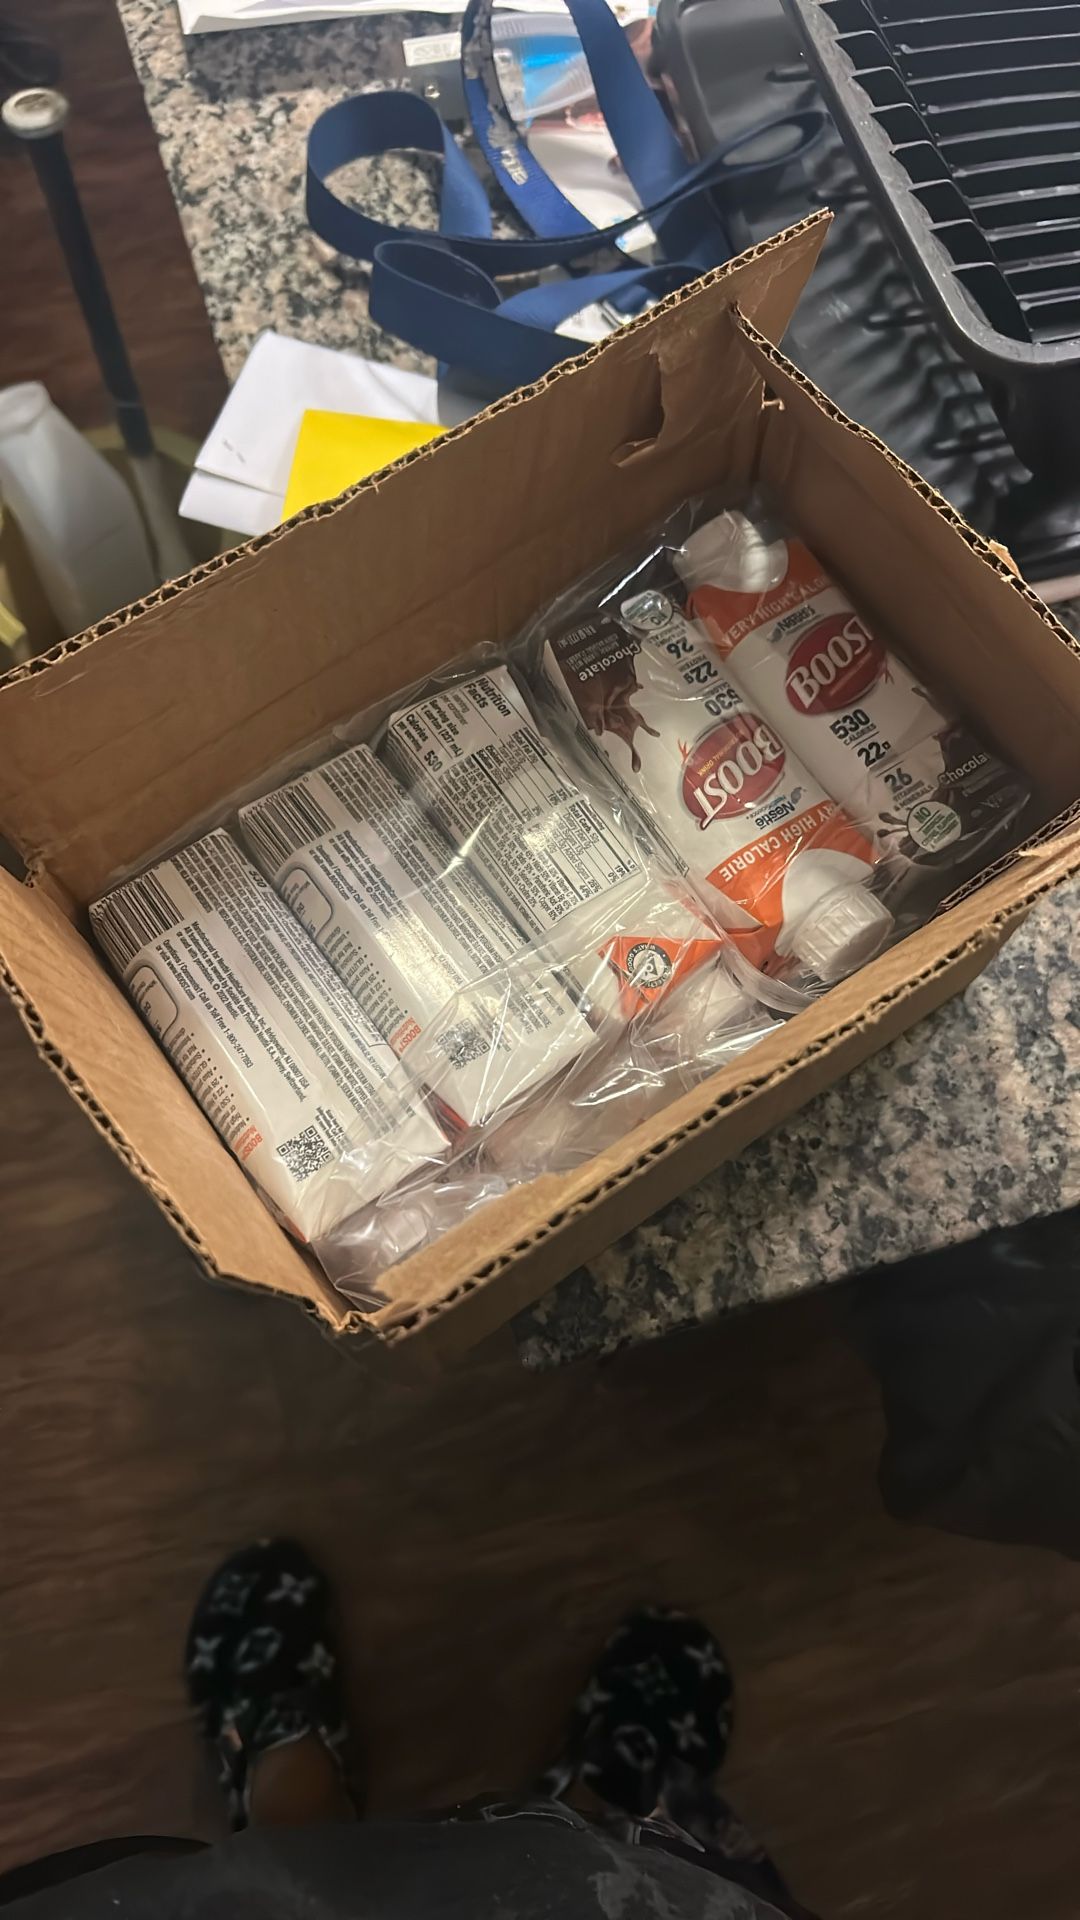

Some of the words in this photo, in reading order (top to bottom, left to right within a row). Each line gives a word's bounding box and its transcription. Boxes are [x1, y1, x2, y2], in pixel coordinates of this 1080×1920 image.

[577, 641, 641, 682] Chocolate
[664, 633, 695, 662] 26
[682, 658, 719, 691] 22g
[464, 680, 489, 710] Facts
[475, 675, 512, 718] Nutrition
[702, 687, 742, 718] 530
[404, 712, 430, 742] Calories
[423, 708, 443, 731] carton
[428, 698, 450, 723] Serving
[446, 720, 460, 736] size
[828, 705, 871, 742] 530
[842, 722, 877, 746] CALORIES
[422, 749, 444, 773] 530
[475, 748, 494, 770] Sodium
[691, 723, 784, 830] BOOST
[882, 765, 914, 794] 26
[779, 814, 817, 841] HIGH
[913, 805, 931, 824] NO
[718, 834, 781, 882] CALORIE
[162, 938, 182, 964] Questions
[179, 964, 203, 994] Comments?
[165, 959, 196, 1001] www.BOOST.com
[194, 956, 215, 984] permission.
[190, 920, 216, 953] Manufactured
[226, 971, 247, 998] HealthCare
[242, 995, 261, 1019] Nutrition,
[264, 1027, 288, 1058] Bridgewater,
[188, 931, 209, 959] trademarks
[282, 1070, 307, 1102] Switzerland,
